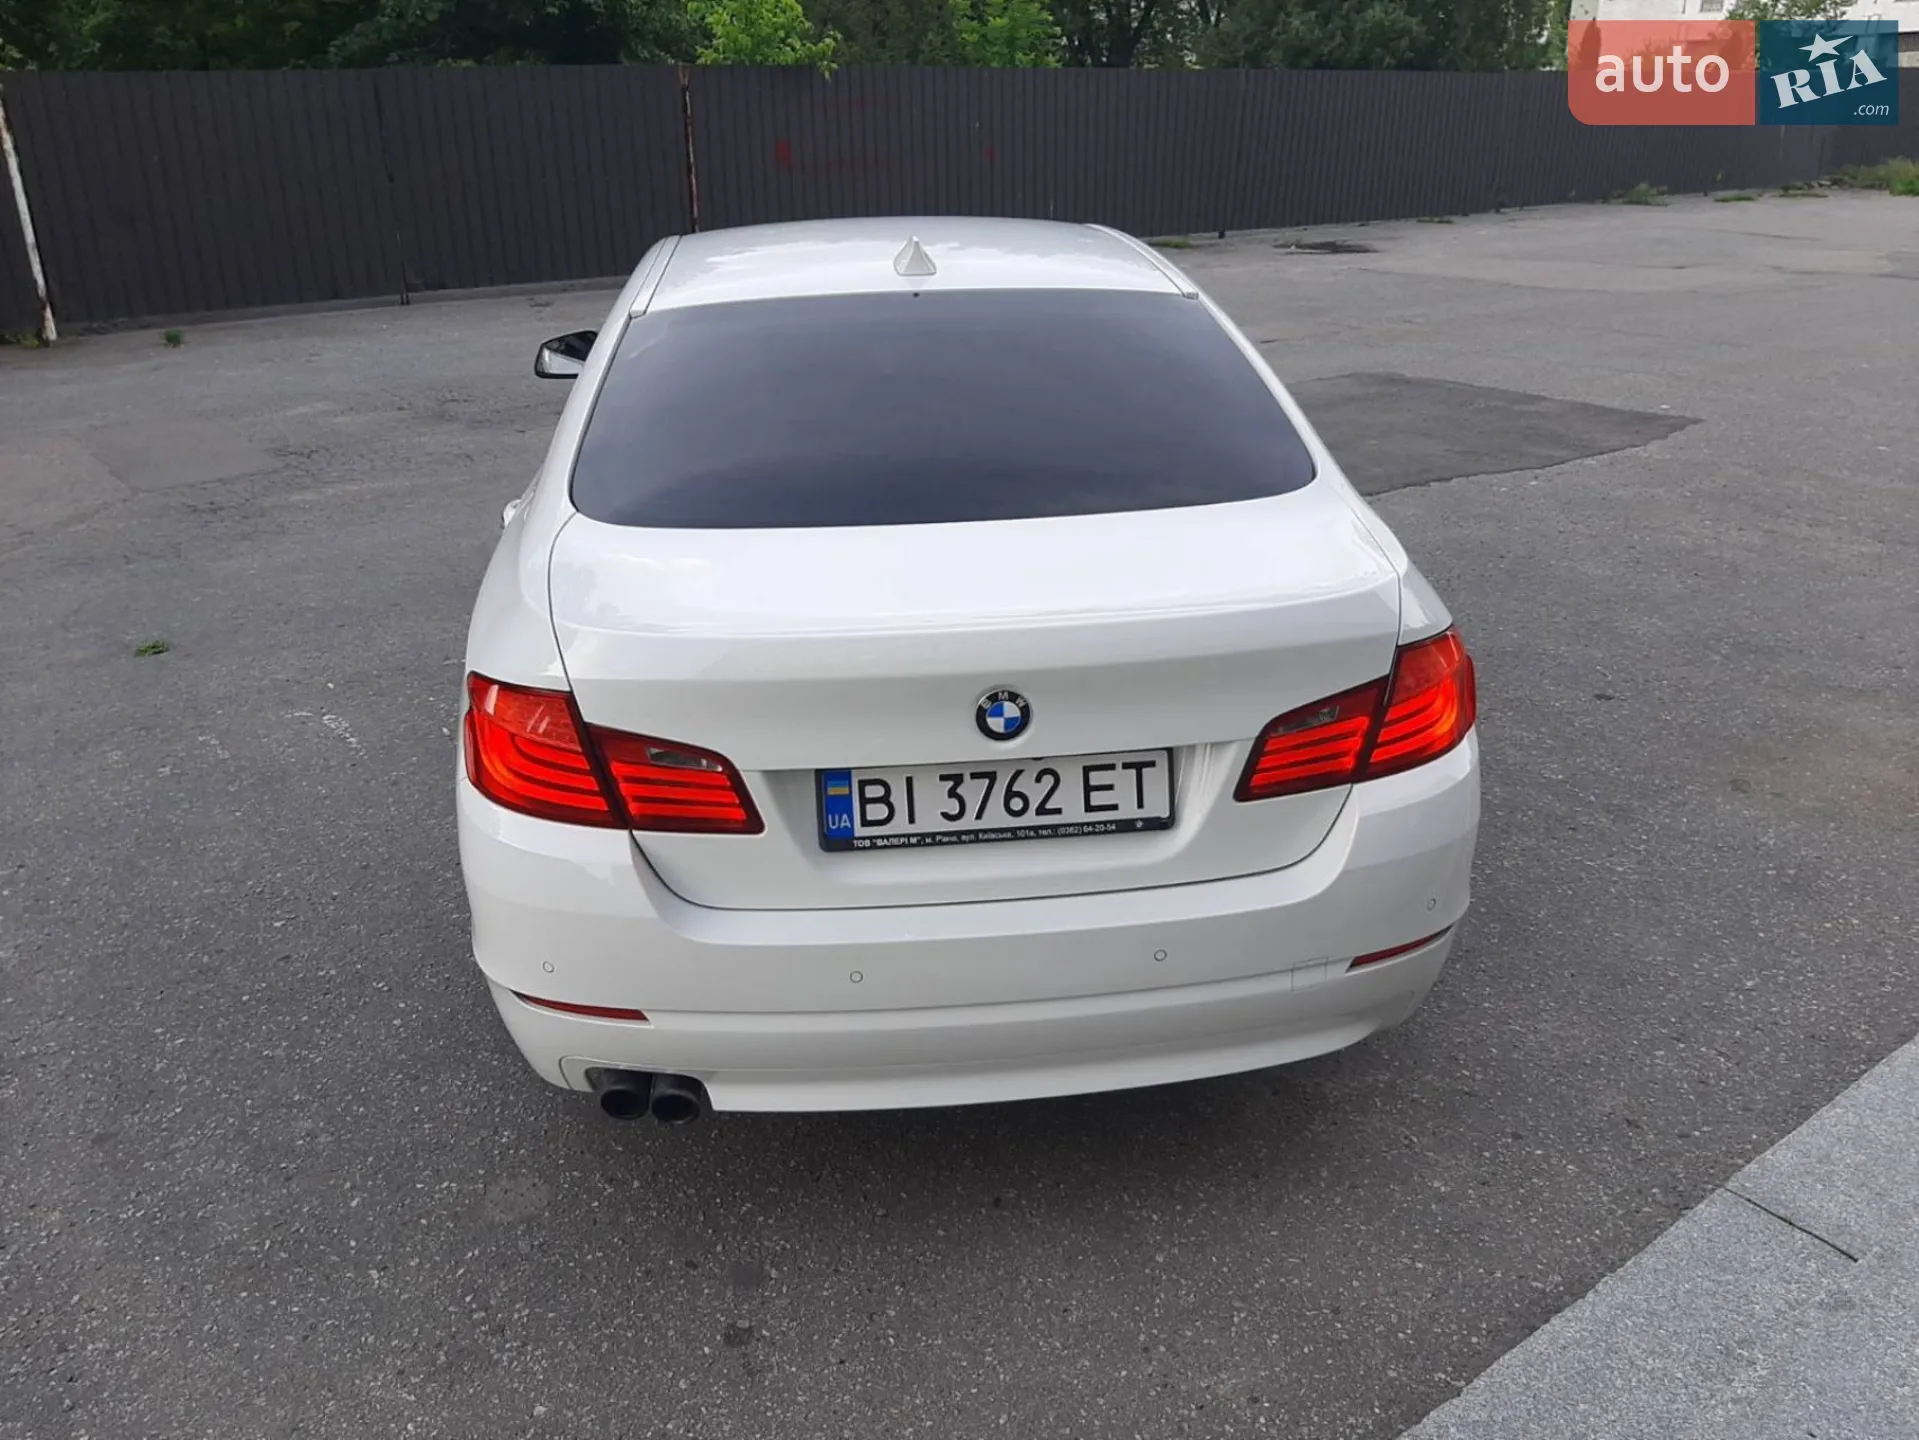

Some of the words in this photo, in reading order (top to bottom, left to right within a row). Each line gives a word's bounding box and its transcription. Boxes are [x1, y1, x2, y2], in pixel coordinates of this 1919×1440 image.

[980, 691, 1027, 709] BMW
[857, 775, 916, 828] BI
[938, 768, 1063, 823] 3762
[1082, 760, 1157, 813] ET
[828, 813, 851, 830] UA
